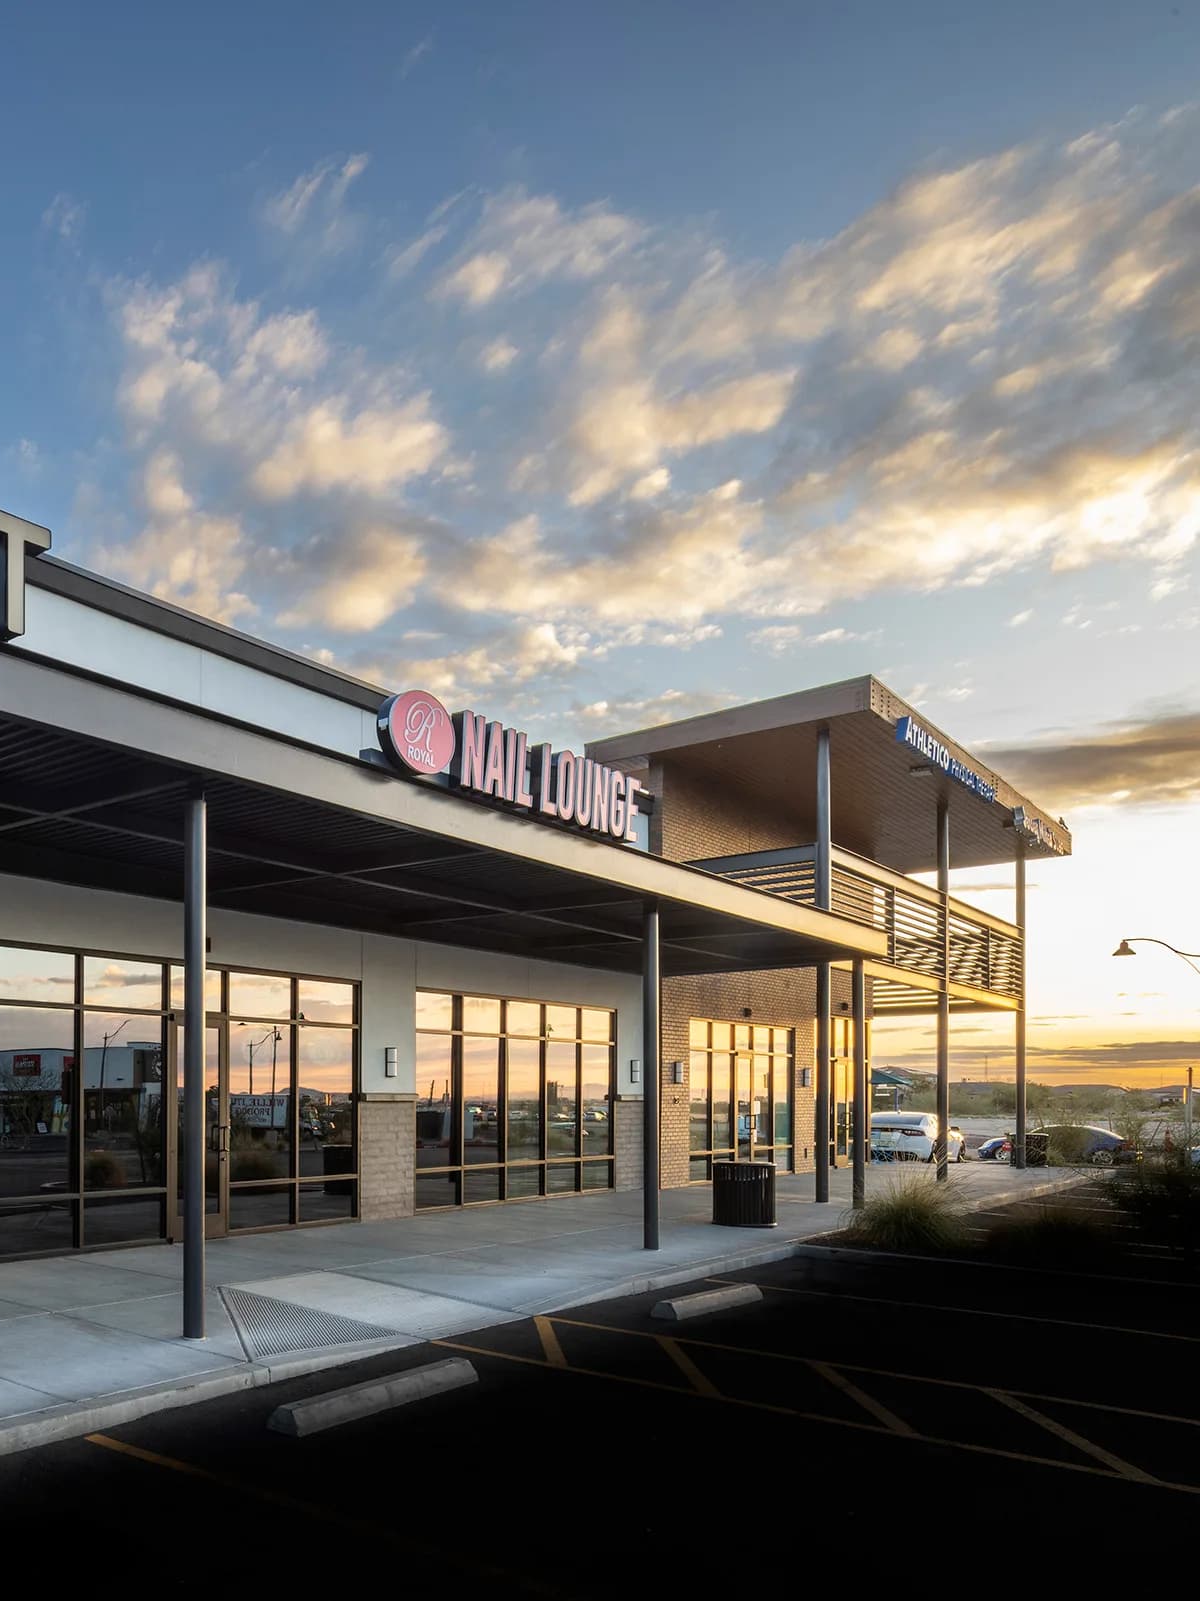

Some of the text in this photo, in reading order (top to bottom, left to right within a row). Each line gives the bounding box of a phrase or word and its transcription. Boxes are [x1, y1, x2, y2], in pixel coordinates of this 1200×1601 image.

[408, 744, 436, 768] ROYAL
[904, 716, 950, 771] ATHLETICO
[455, 710, 643, 843] NAIL LOUNGE
